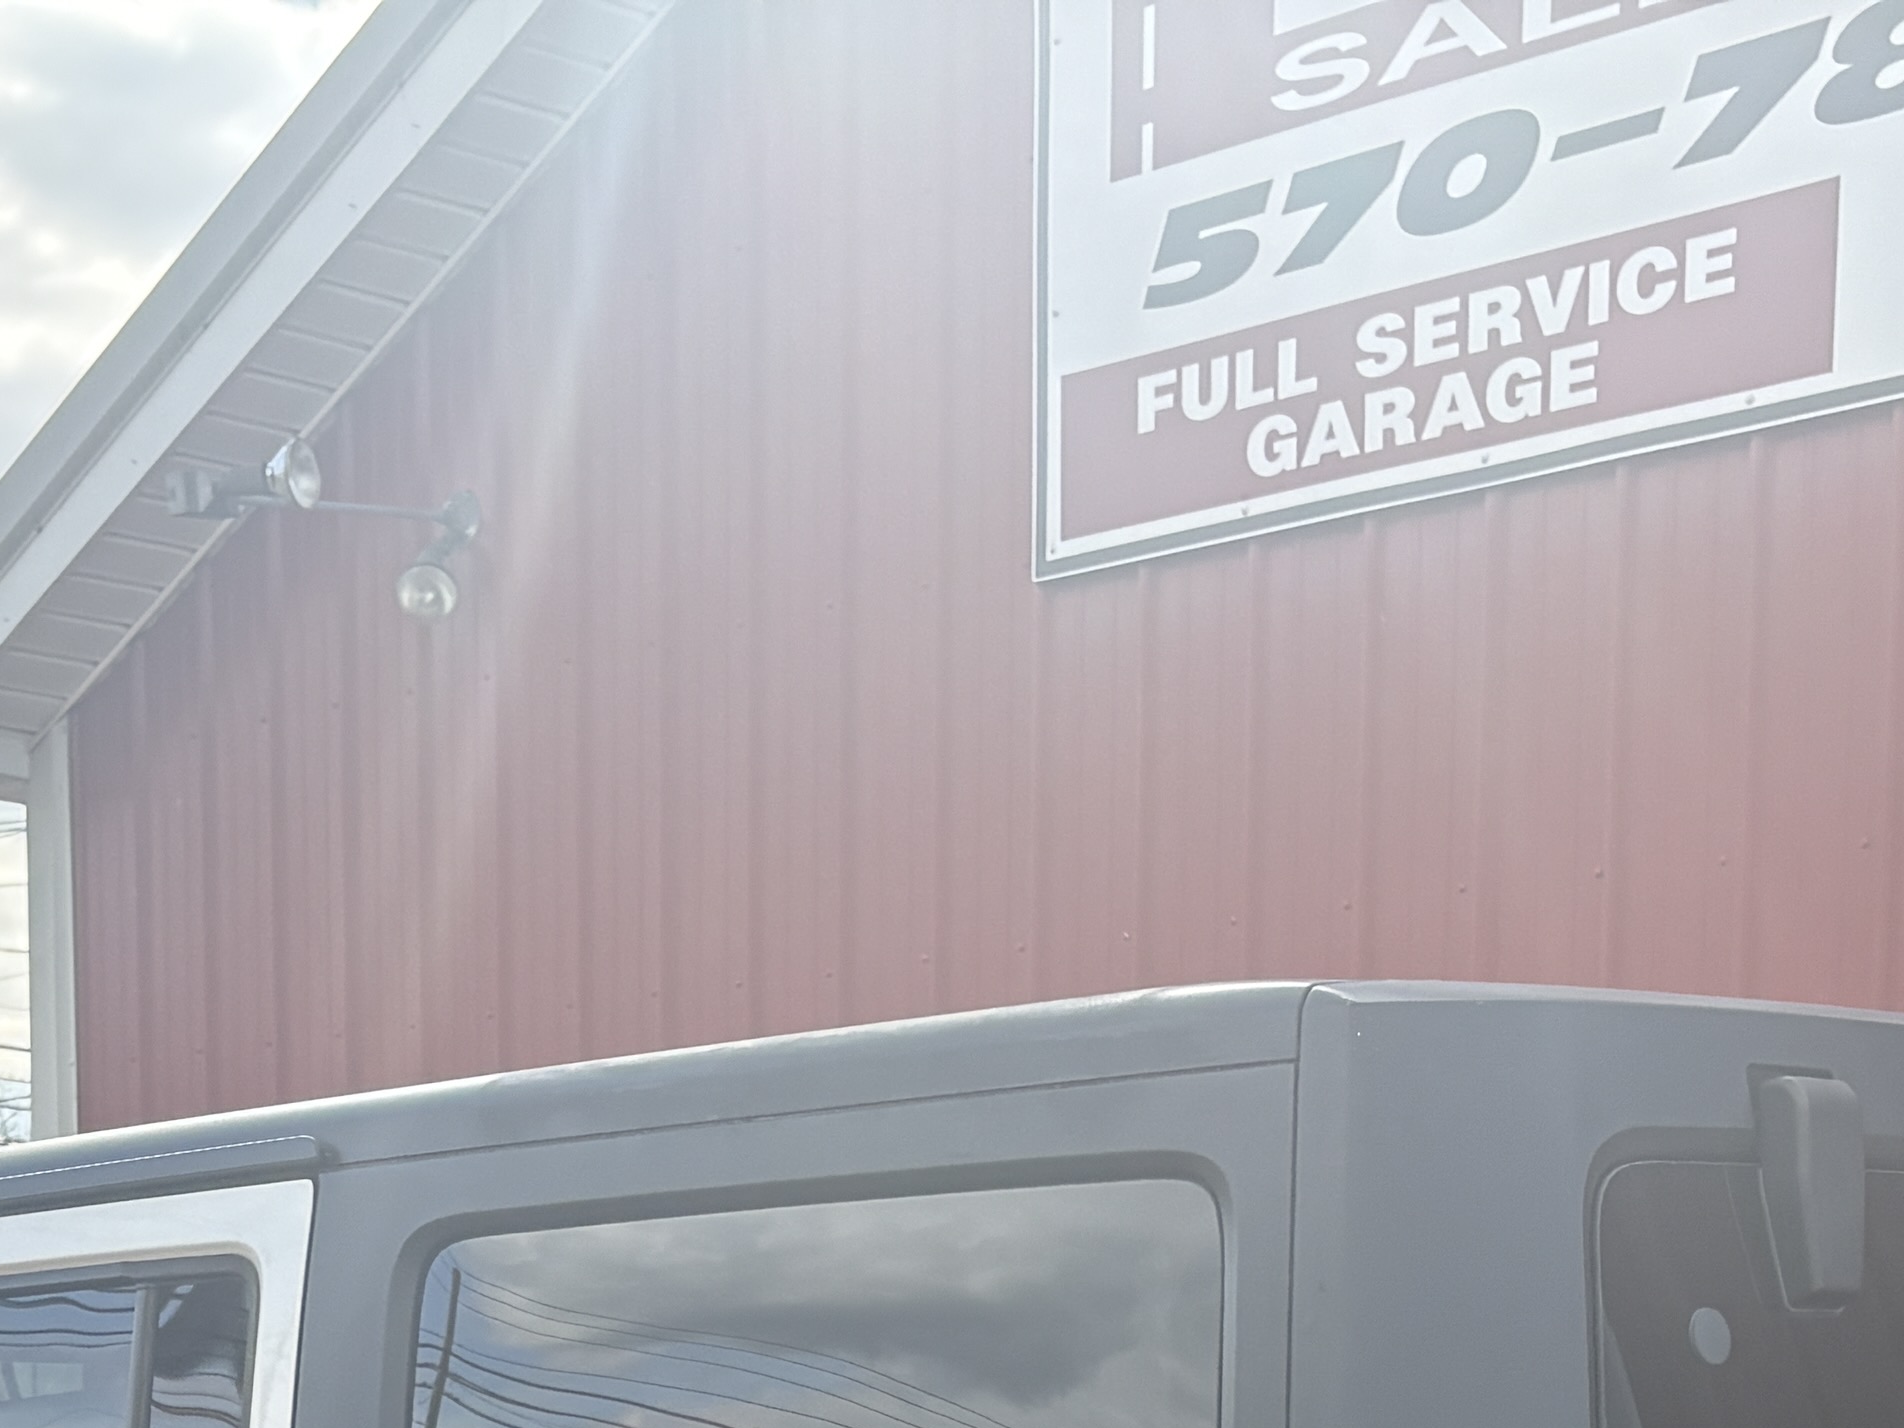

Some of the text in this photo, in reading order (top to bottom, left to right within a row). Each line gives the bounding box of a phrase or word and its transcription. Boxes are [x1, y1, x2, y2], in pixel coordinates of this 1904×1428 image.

[1270, 0, 1667, 111] SAL
[1137, 227, 1738, 434] FULL SERVICE
[1246, 341, 1599, 479] GARAGE
